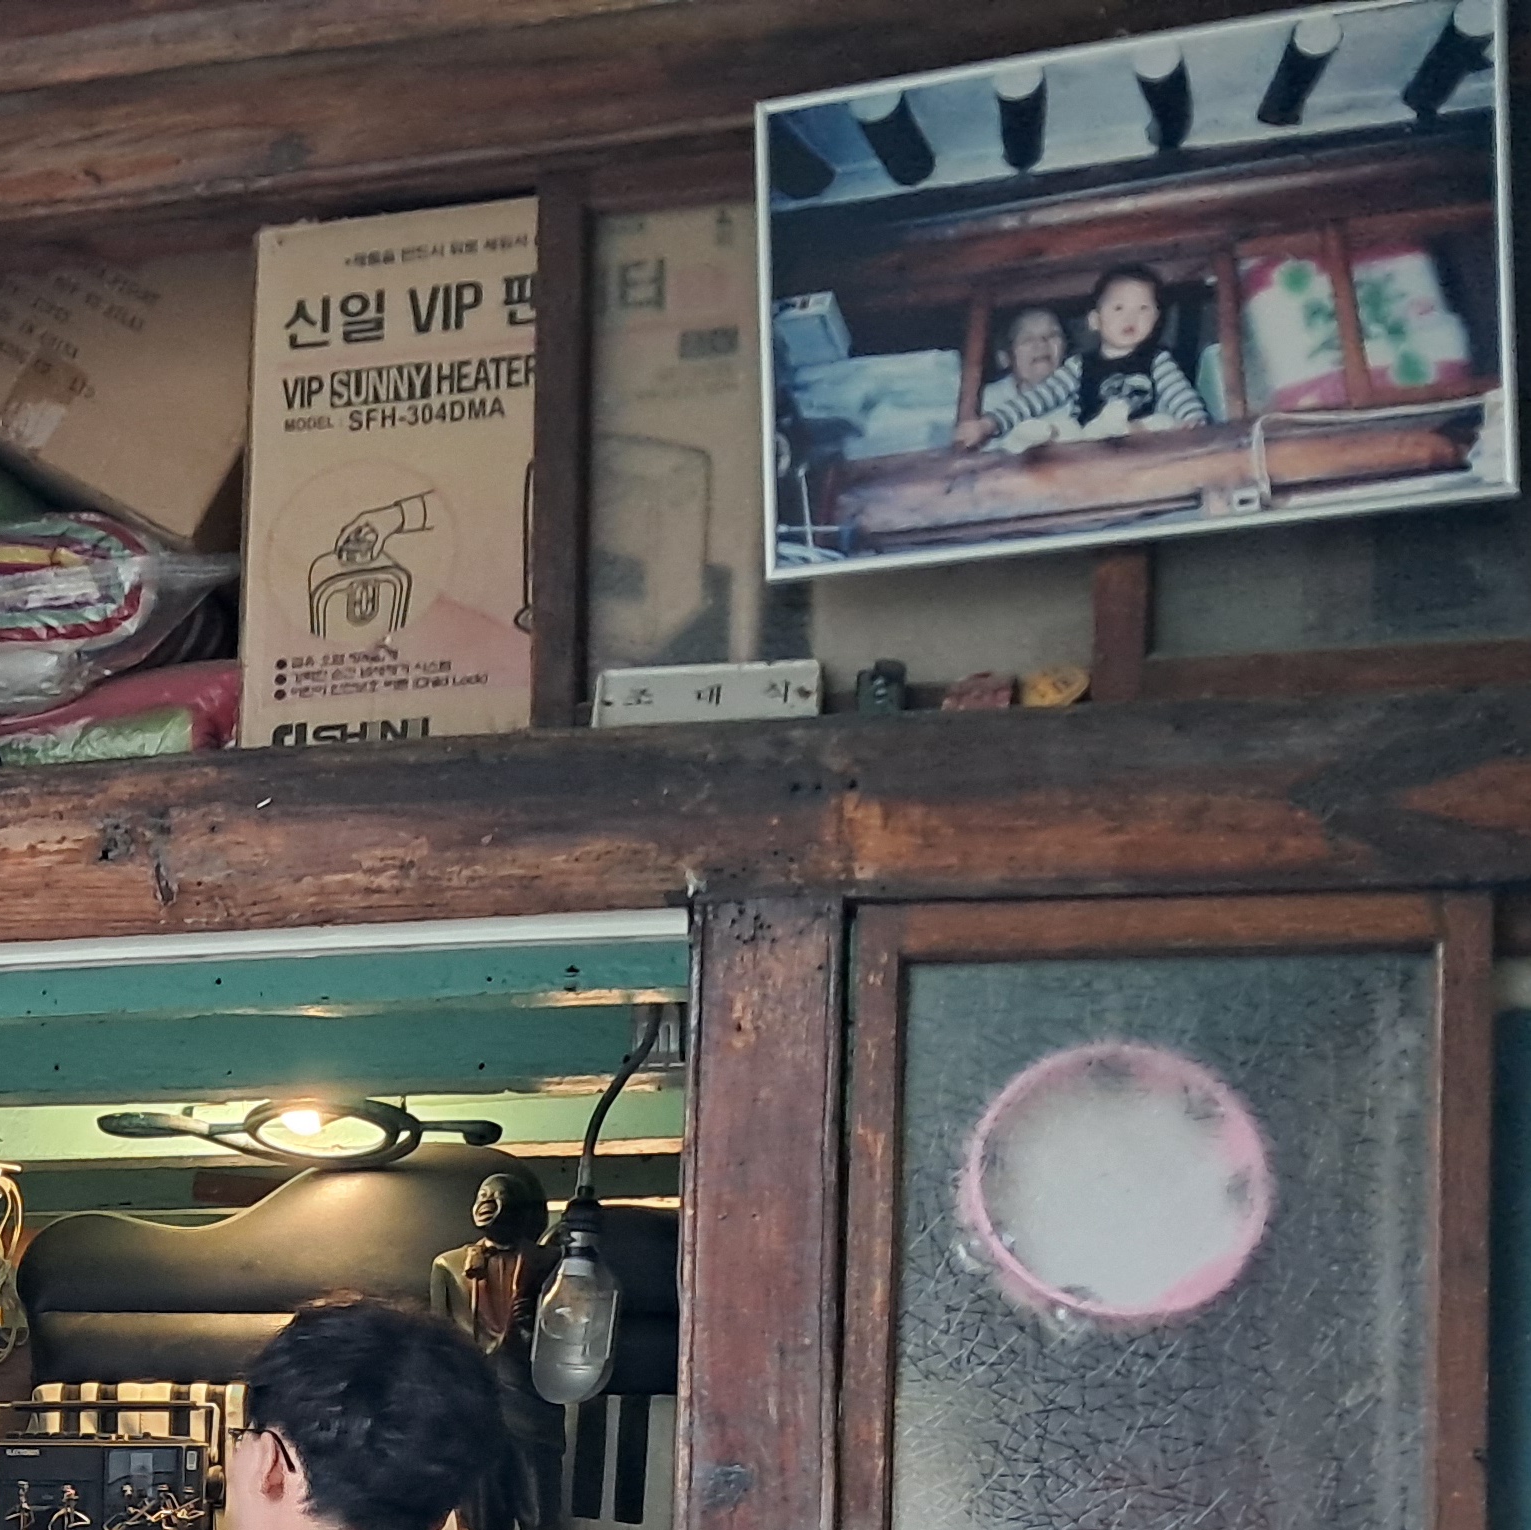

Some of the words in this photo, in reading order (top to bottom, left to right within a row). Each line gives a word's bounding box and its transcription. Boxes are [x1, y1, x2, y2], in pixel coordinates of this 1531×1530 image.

[284, 287, 386, 349] 신일
[408, 280, 484, 333] VIP
[282, 376, 325, 410] VIP
[330, 362, 432, 408] SUNNY
[348, 397, 506, 432] SFH-304DMA
